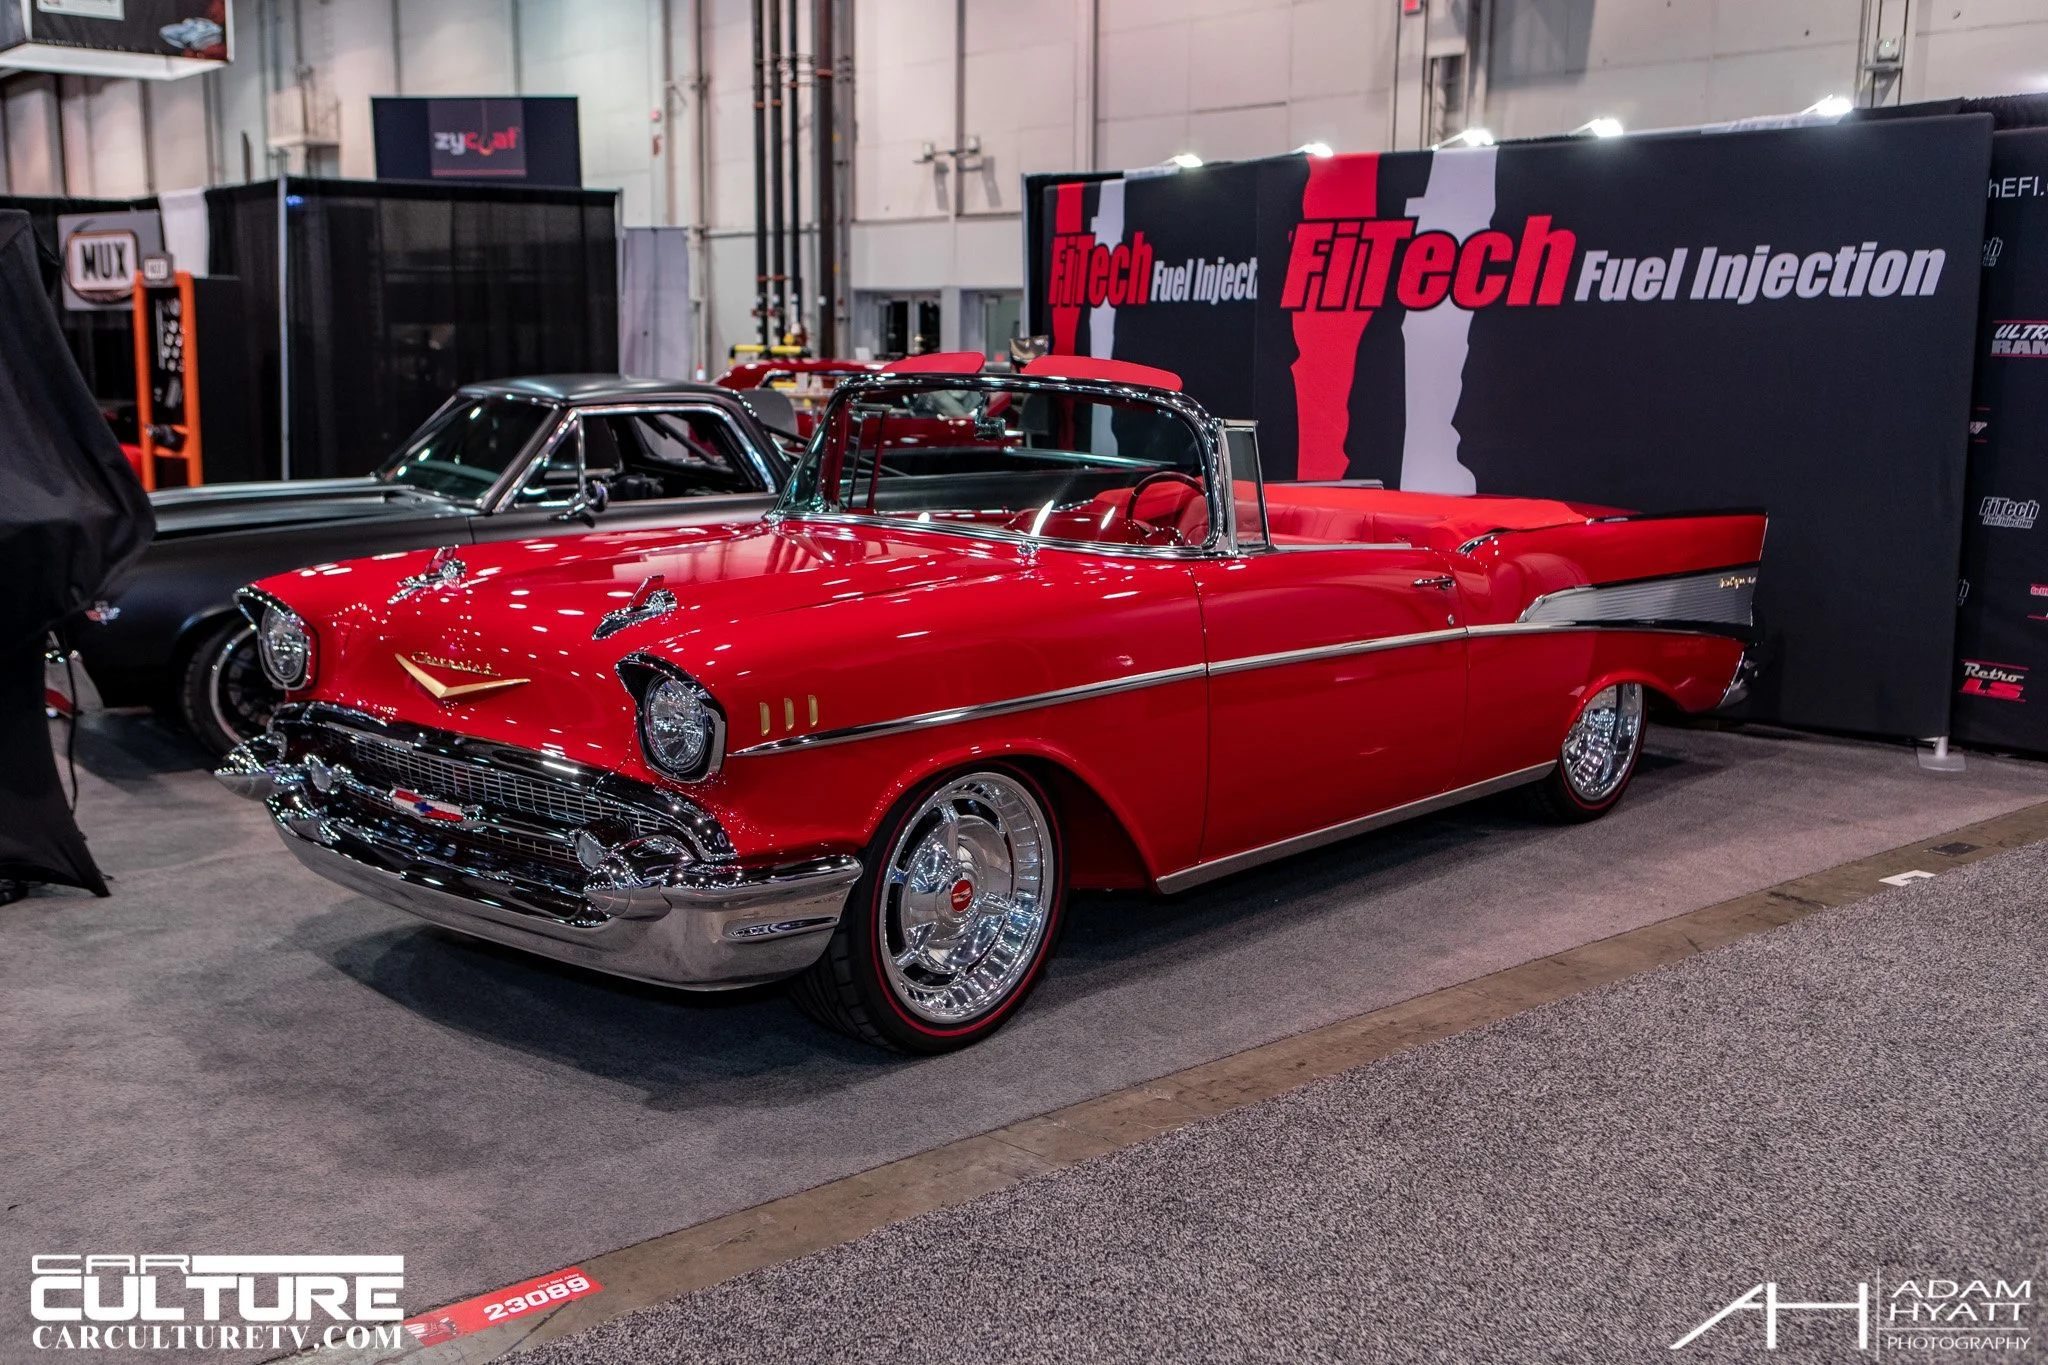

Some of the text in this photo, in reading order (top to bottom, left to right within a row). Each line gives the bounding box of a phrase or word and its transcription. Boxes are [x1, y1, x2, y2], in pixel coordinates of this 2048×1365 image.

[1987, 176, 2048, 198] hEFI.
[81, 241, 128, 280] MUX
[1049, 231, 1153, 307] FiTech
[1150, 260, 1194, 302] Fuel
[1280, 214, 1577, 310] FiTech
[1574, 248, 1688, 301] Fuel
[1690, 241, 1946, 305] Injection
[1979, 496, 2040, 520] FiTech
[1964, 662, 2024, 682] Retro
[1962, 678, 2024, 698] LS
[483, 1277, 590, 1321] 23089
